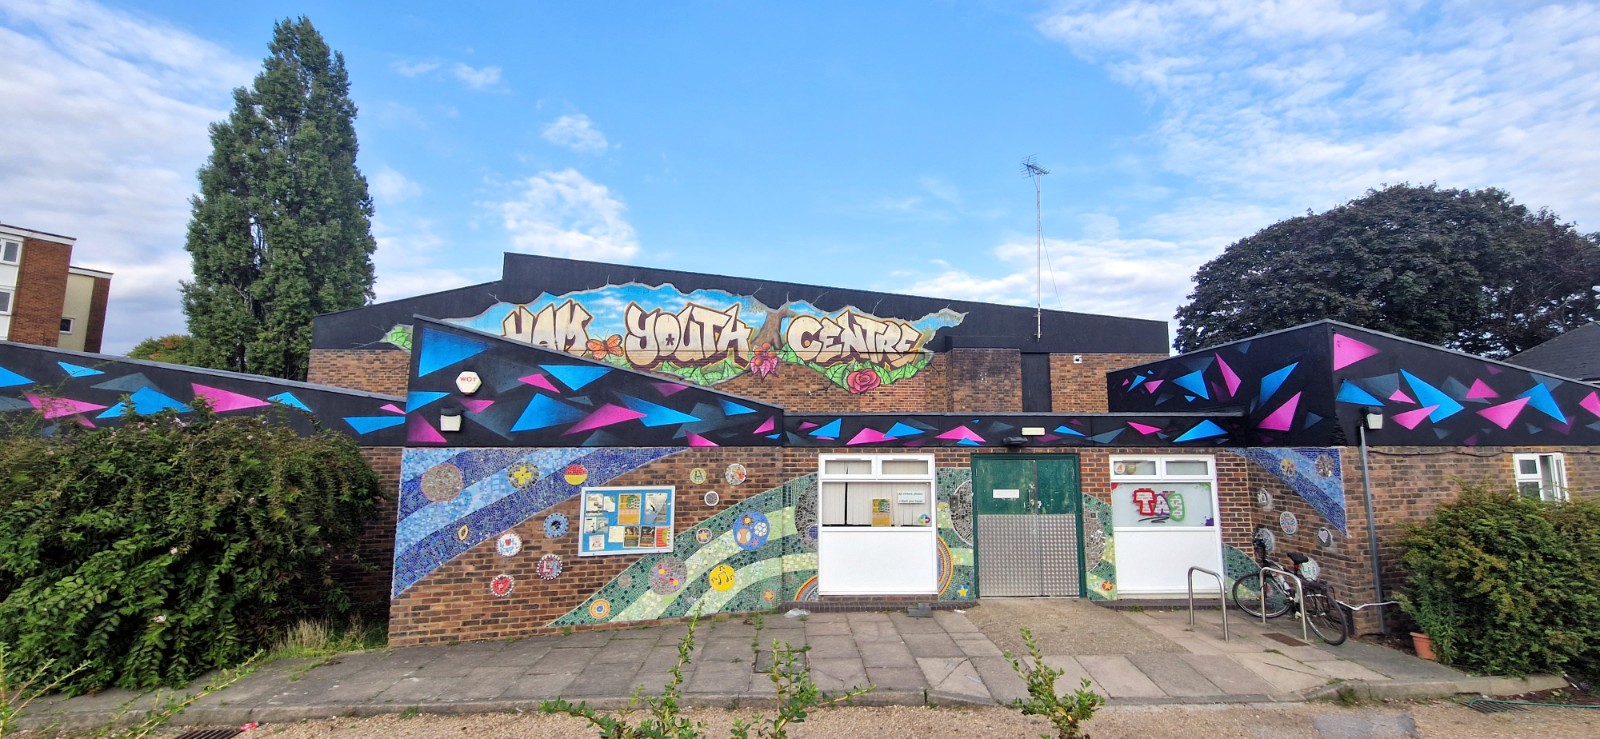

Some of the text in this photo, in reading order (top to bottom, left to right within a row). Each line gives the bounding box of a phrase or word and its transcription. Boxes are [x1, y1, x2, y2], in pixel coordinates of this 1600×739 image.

[502, 300, 923, 368] HAM YOUTH CENTRE
